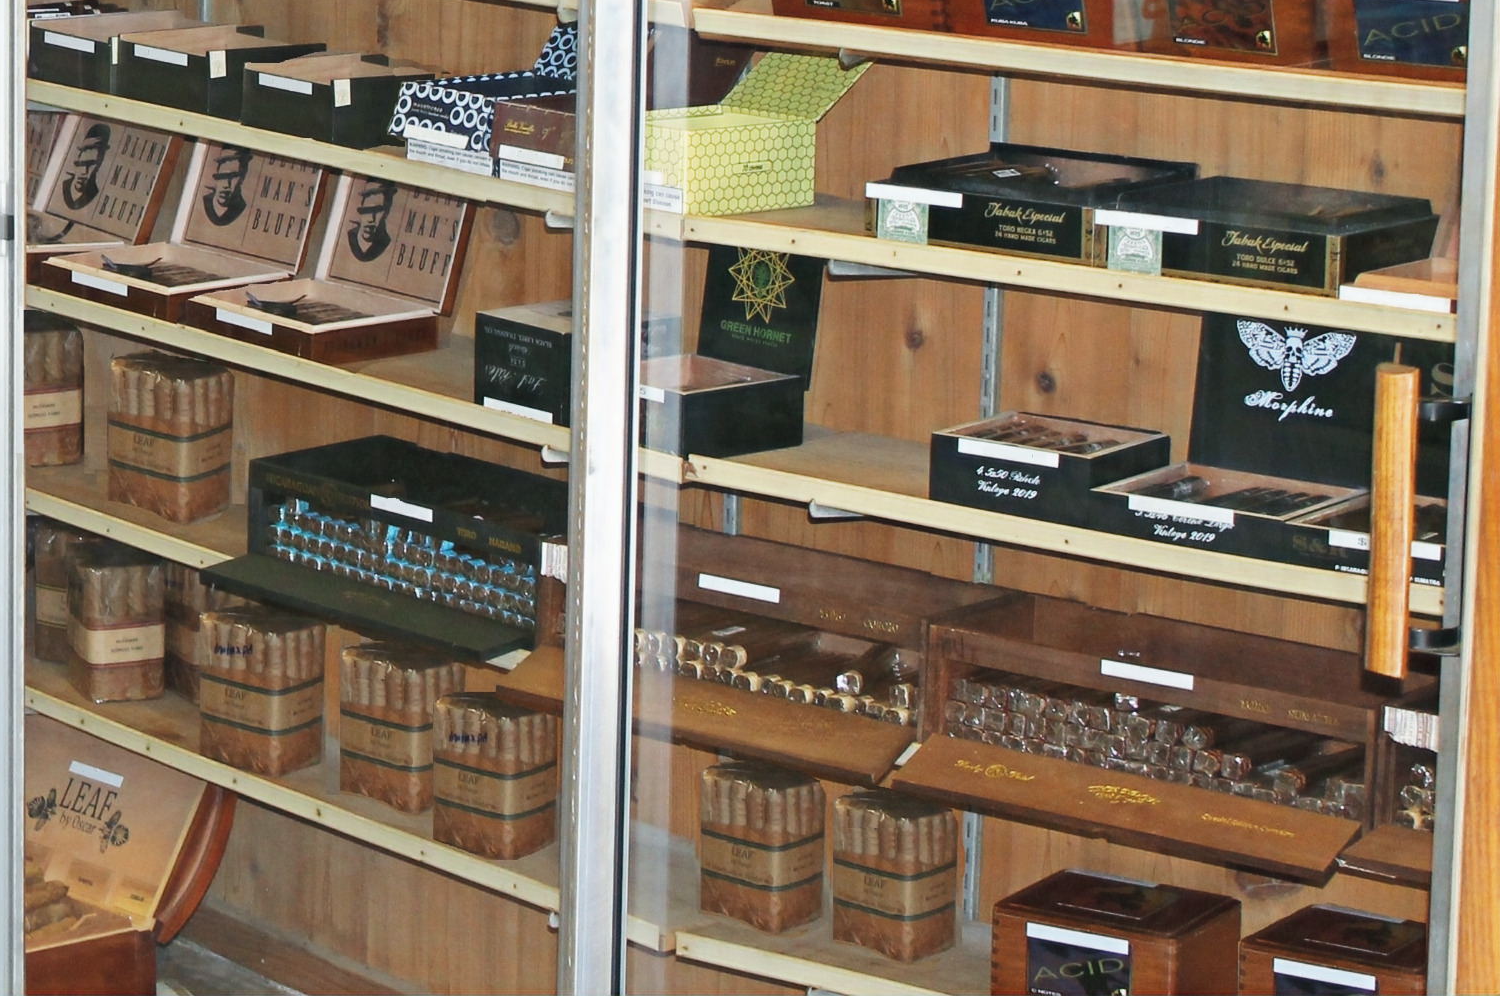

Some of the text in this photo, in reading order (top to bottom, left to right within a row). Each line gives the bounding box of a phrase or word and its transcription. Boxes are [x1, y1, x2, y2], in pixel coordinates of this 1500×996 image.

[1364, 12, 1462, 46] ACID
[121, 133, 167, 167] BLIND
[110, 164, 156, 197] MAN'S
[260, 176, 315, 205] MAN'S
[666, 192, 680, 200] cause
[404, 209, 459, 243] MAN'S
[984, 202, 1067, 226] Tabak Especial
[999, 224, 1036, 236] TORO NEGRA
[1003, 232, 1019, 241] HAND
[1020, 233, 1036, 243] MADE
[1037, 235, 1056, 245] CIGARS
[1221, 230, 1309, 254] Tabak Especial
[396, 243, 452, 278] BLUFF
[1236, 253, 1277, 265] TORO DULCE
[1241, 261, 1258, 270] HAND
[1259, 262, 1276, 272] MADE
[1277, 264, 1298, 275] CIGARS
[720, 320, 793, 344] GREEN HORNET
[1244, 389, 1334, 421] Morphine
[977, 479, 1038, 500] Vintage 2019
[1153, 523, 1216, 543] Vintage 2019
[59, 778, 118, 821] LEAF
[59, 810, 97, 836] by Oscar
[1032, 958, 1125, 983] ACID
